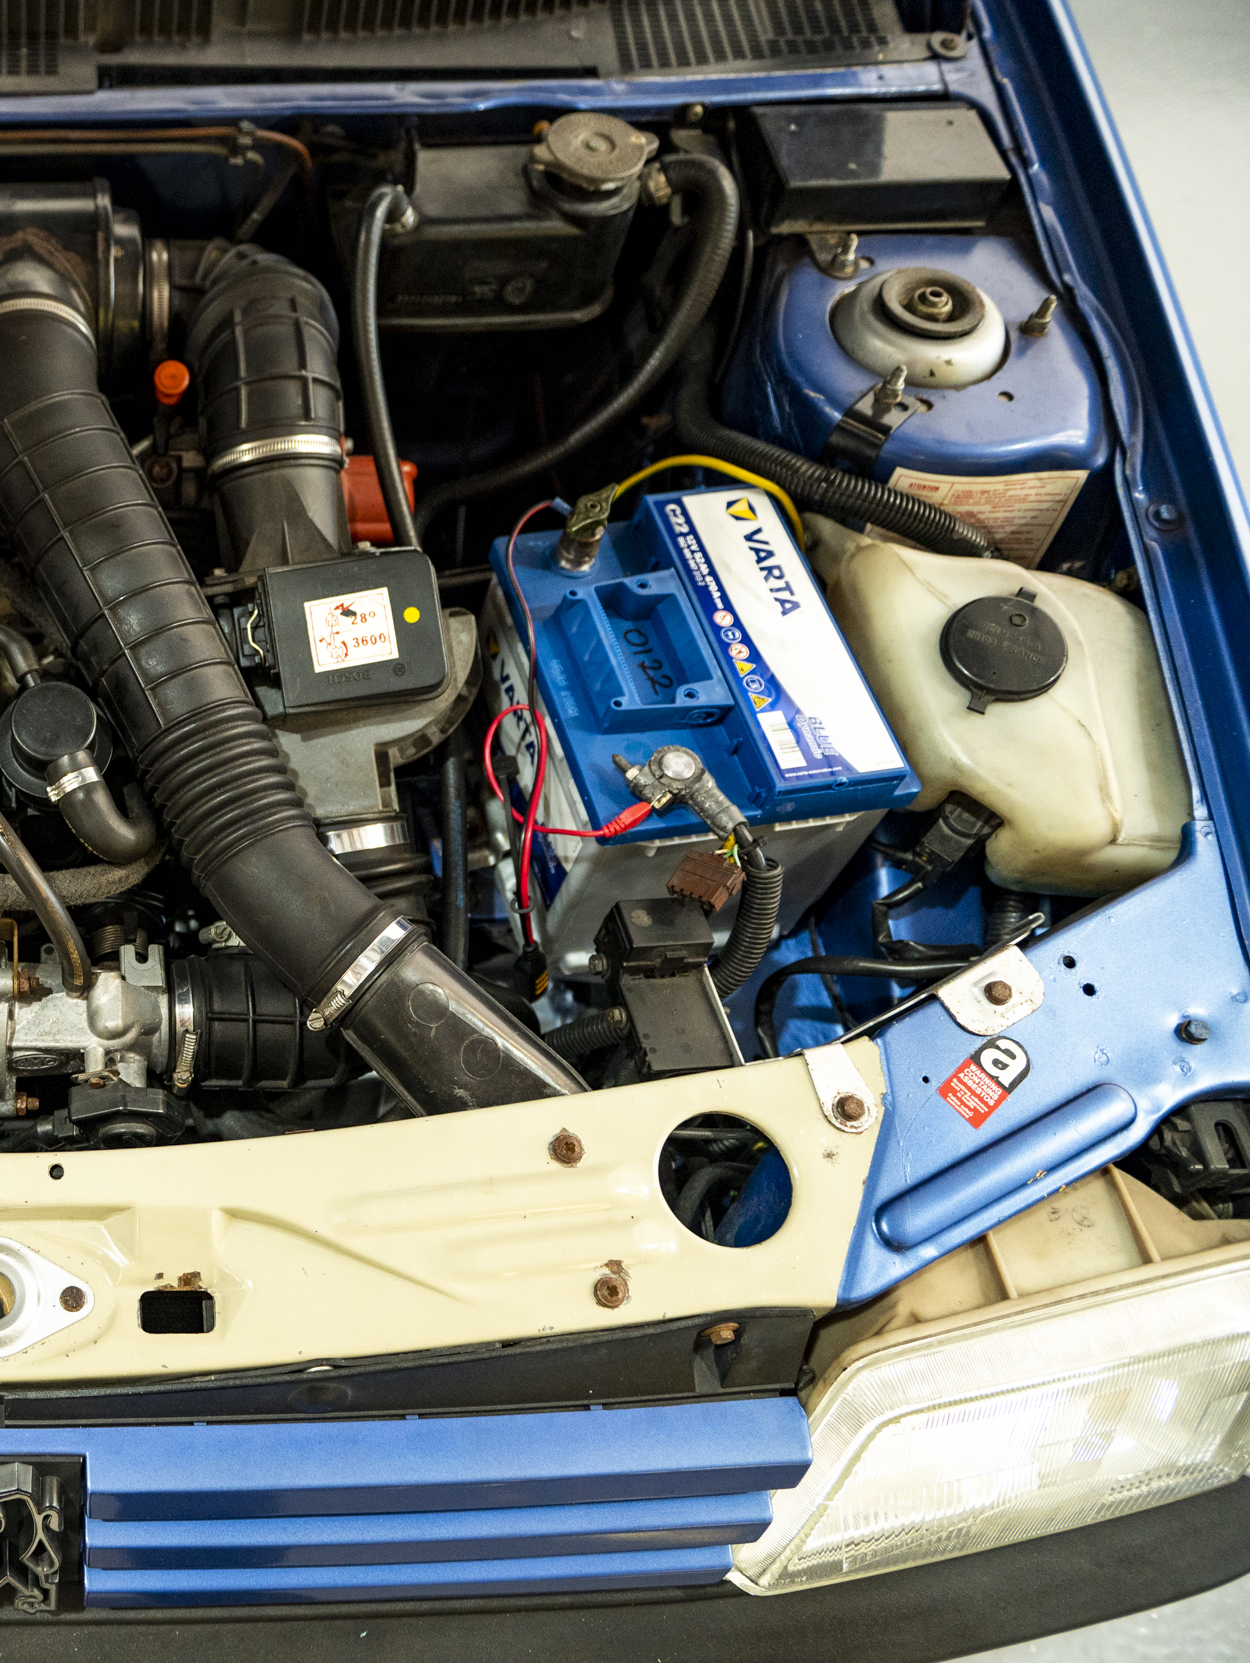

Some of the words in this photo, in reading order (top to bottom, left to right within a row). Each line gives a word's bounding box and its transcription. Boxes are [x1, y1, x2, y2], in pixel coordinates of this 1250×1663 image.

[662, 503, 691, 533] C22
[684, 535, 700, 551] 12V
[743, 526, 801, 617] VARTA
[352, 632, 387, 648] 3600
[623, 628, 674, 695] 0122
[795, 715, 822, 759] Dynamic
[808, 717, 838, 755] BLUE
[968, 1064, 1002, 1095] WARNING
[979, 1038, 1028, 1088] a
[949, 1081, 960, 1091] dust
[962, 1094, 985, 1114] dangerous
[951, 1077, 971, 1096] Breathing
[969, 1094, 989, 1112] asbestos
[956, 1071, 996, 1106] ASBESTOS
[962, 1067, 999, 1100] CONTAINS
[945, 1096, 970, 1118] instructions
[947, 1092, 961, 1105] Follow
[959, 1103, 974, 1117] safety
[960, 1096, 974, 1109] health
